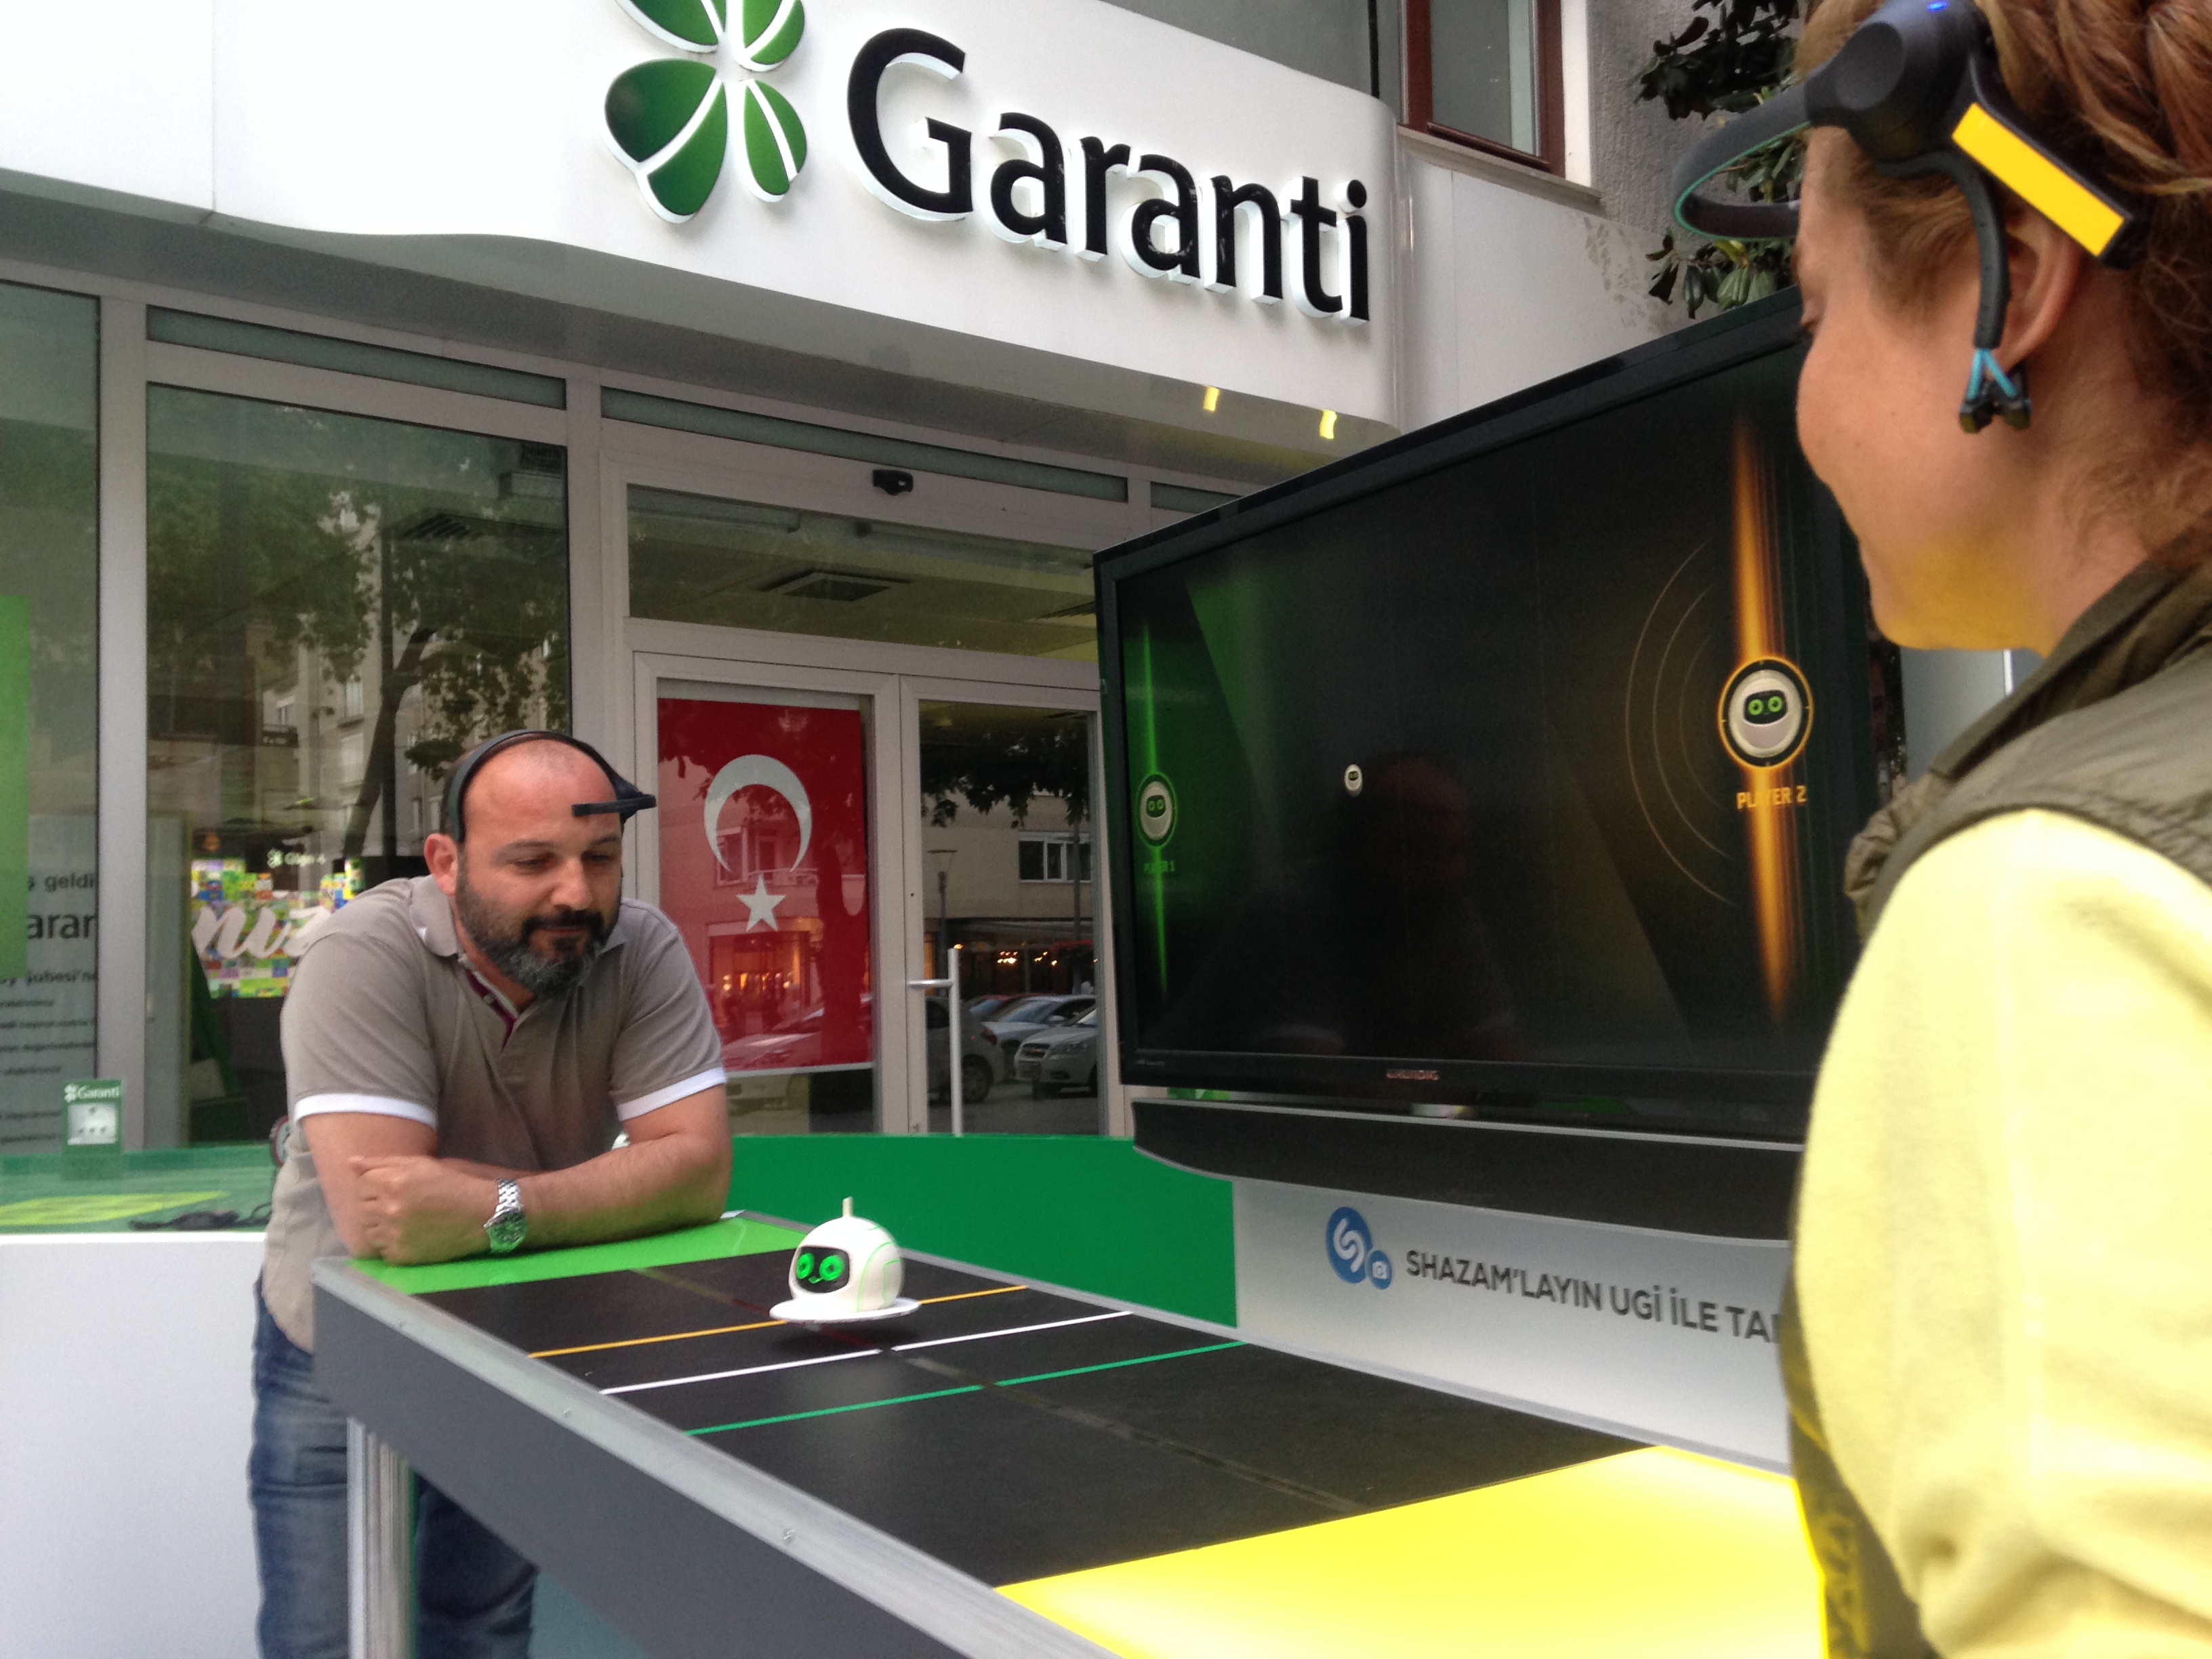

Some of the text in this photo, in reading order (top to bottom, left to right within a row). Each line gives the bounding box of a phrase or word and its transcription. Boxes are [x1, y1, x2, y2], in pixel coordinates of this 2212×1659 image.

[846, 27, 1370, 323] Garanti
[1736, 784, 1808, 810] PLER 2
[77, 1086, 120, 1099] Garanti
[1406, 1249, 1603, 1311] SHAZAM'LAYIN
[1609, 1285, 1662, 1323] UGİ
[1669, 1288, 1719, 1333] İLE
